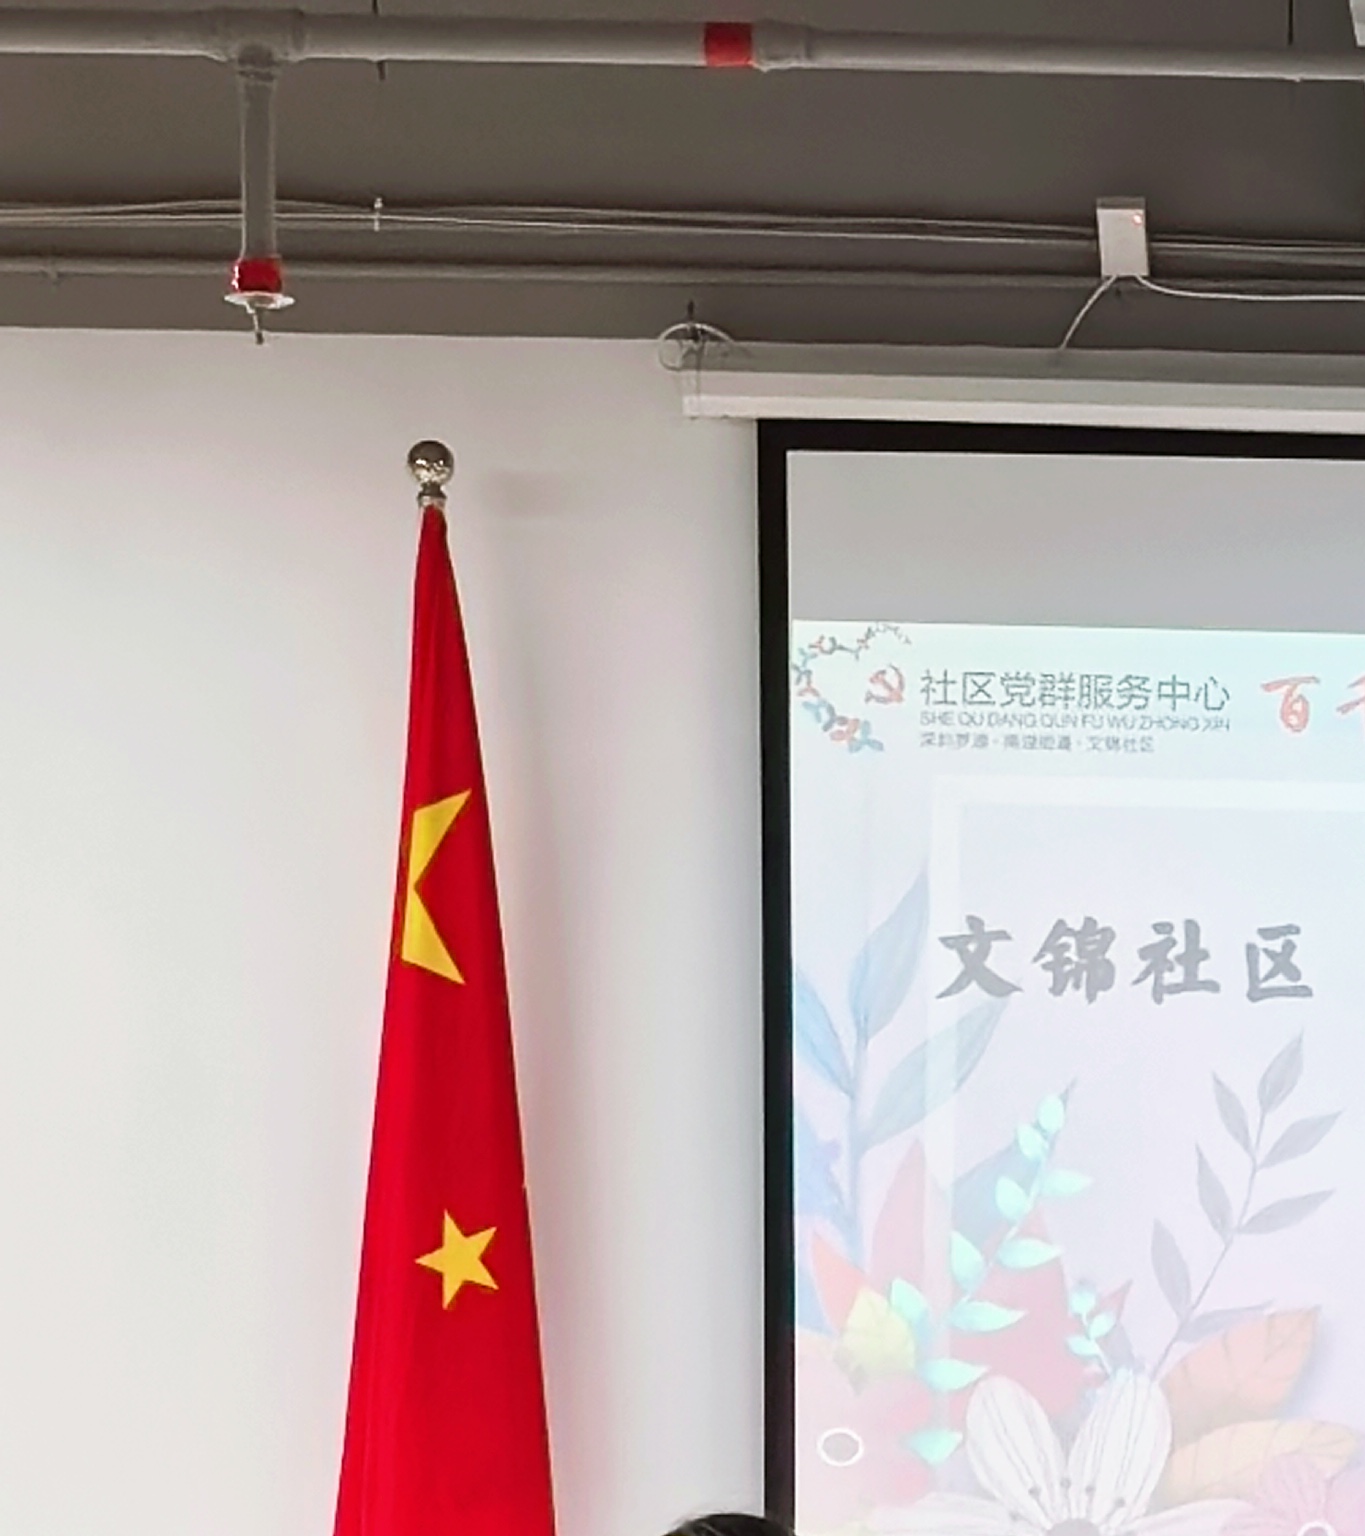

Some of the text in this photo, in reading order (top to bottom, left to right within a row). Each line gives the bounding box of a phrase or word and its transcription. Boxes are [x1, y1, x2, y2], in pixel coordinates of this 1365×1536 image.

[919, 669, 1231, 711] 社区党群服务中心
